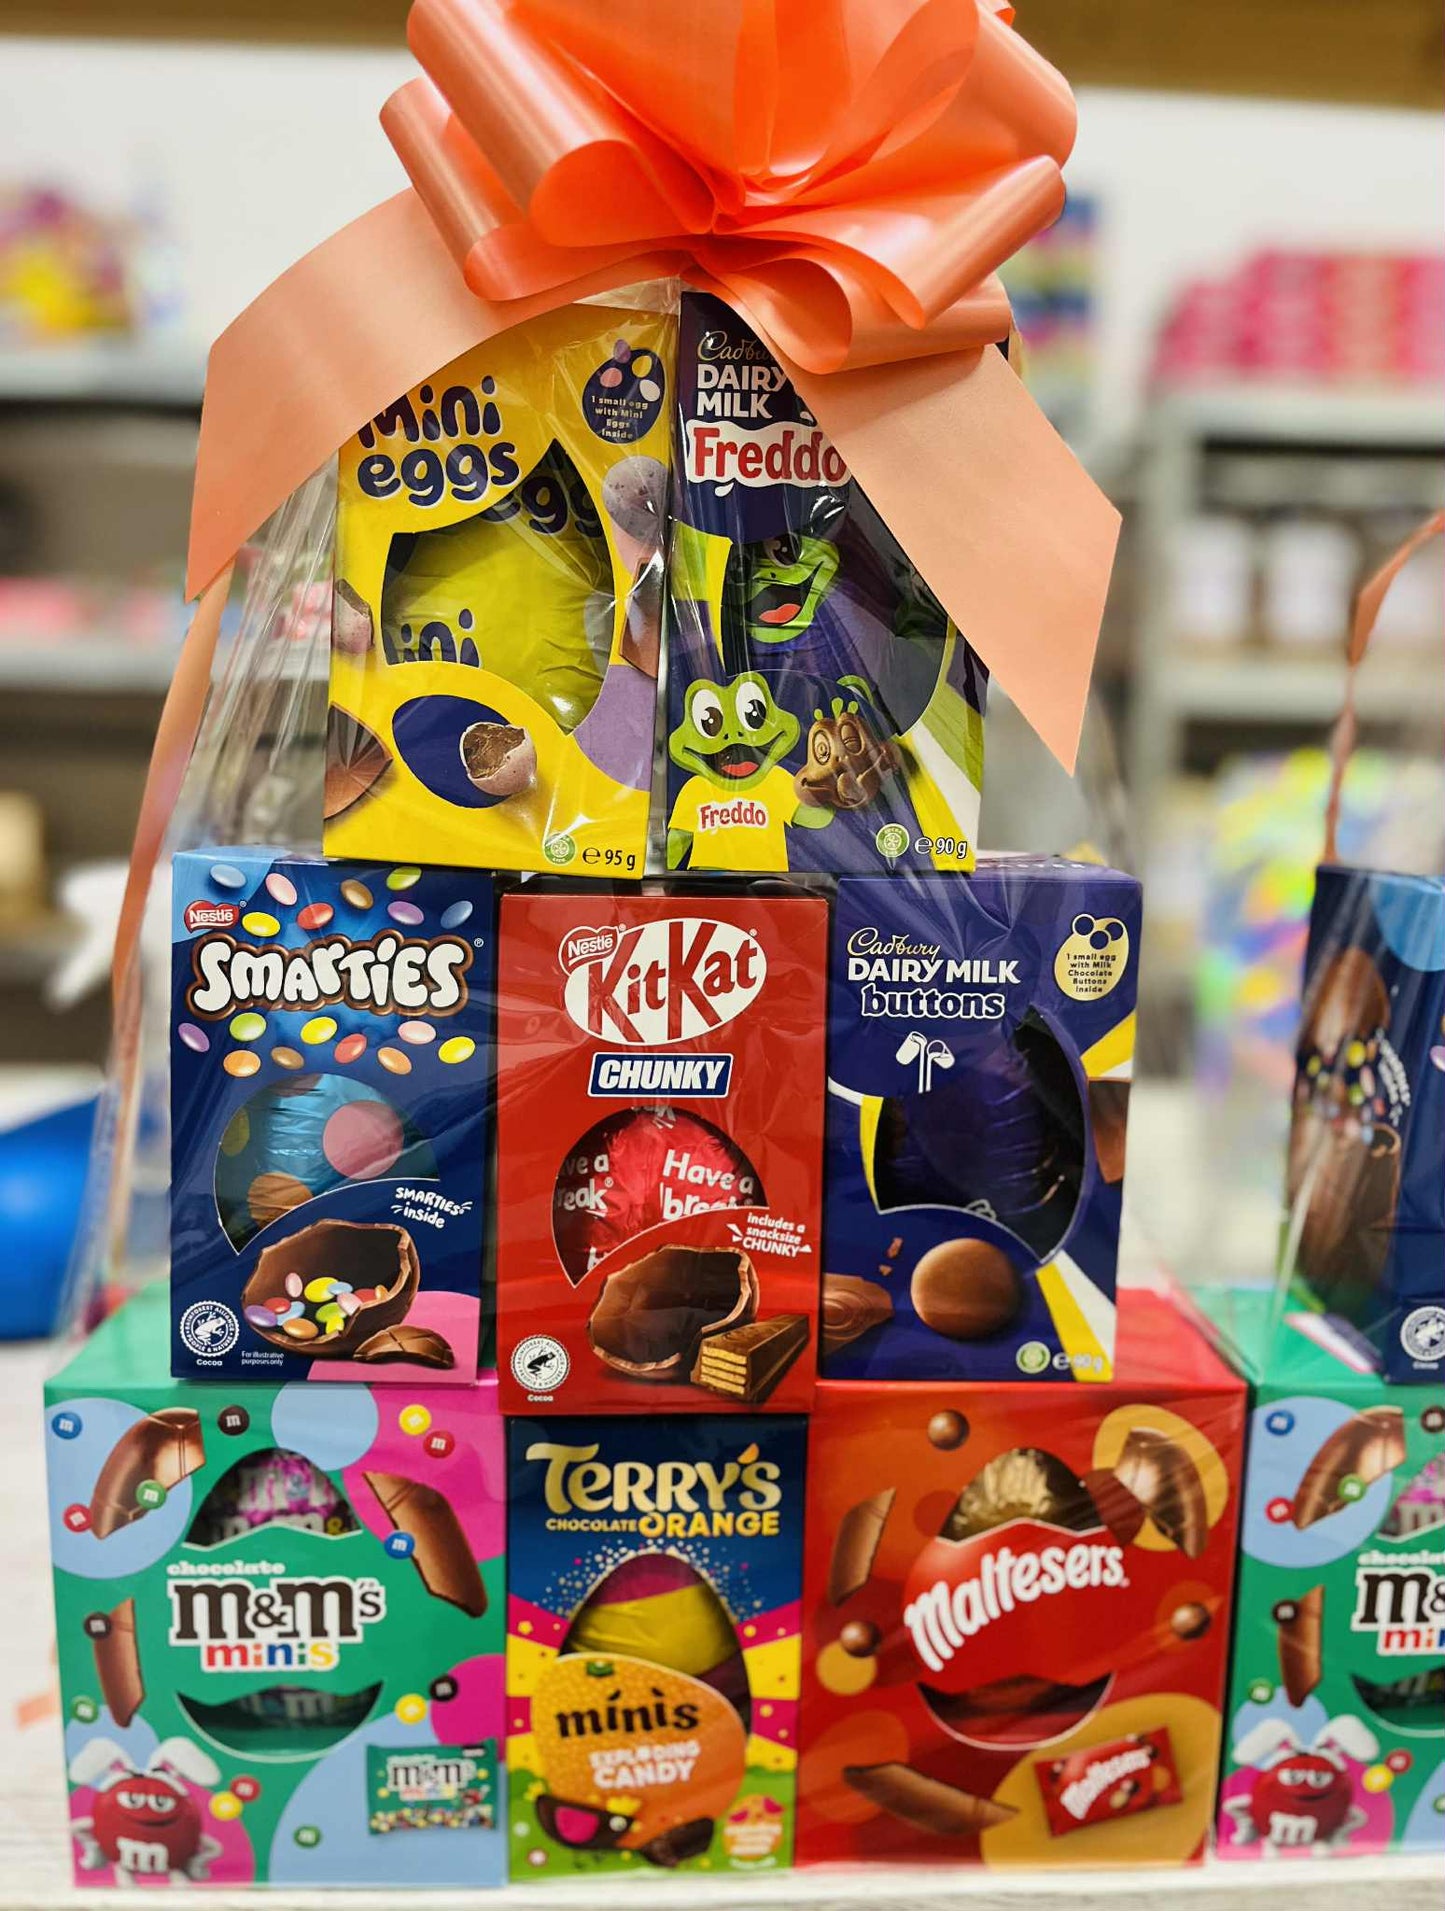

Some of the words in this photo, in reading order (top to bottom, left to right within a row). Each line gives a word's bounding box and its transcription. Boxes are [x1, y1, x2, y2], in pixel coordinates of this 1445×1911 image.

[697, 331, 773, 361] Cadbu
[697, 364, 787, 391] DAIRY
[591, 395, 596, 403] 1
[598, 397, 626, 406] small
[628, 401, 649, 410] egg
[594, 407, 618, 416] with
[620, 409, 643, 419] Mini
[697, 392, 772, 419] MILK
[606, 419, 630, 429] Eggs
[693, 427, 847, 482] Freddo
[358, 442, 520, 507] eggs
[700, 801, 766, 829] Freddo
[605, 849, 623, 866] 95
[627, 854, 636, 871] g
[936, 837, 954, 855] 90
[957, 841, 968, 859] g
[847, 927, 941, 963] Cadbury
[588, 921, 758, 1043] KitKat
[848, 958, 944, 983] DAIRY
[946, 960, 1021, 984] MILK
[861, 983, 1005, 1019] buttons
[598, 1060, 726, 1090] CHUNKY
[594, 1154, 610, 1172] a
[663, 1149, 735, 1190] Have
[738, 1176, 754, 1194] a
[395, 1187, 461, 1216] SMARTIES
[403, 1201, 445, 1228] inside
[746, 1227, 802, 1244] snacksize
[747, 1212, 795, 1231] includes
[796, 1224, 806, 1233] a
[743, 1237, 800, 1258] CHUNKY
[196, 1358, 223, 1366] Cocoa
[252, 1351, 284, 1359] illustrative
[545, 1518, 638, 1532] CHOCOLATE
[638, 1511, 780, 1538] ORANGE
[166, 1561, 286, 1576] chocolate
[904, 1543, 1125, 1672] Maltesers
[206, 1641, 335, 1667] minis
[555, 1687, 700, 1738] minis
[593, 1759, 696, 1790] CANDY
[1270, 1812, 1318, 1845] m
[117, 1837, 170, 1873] m
